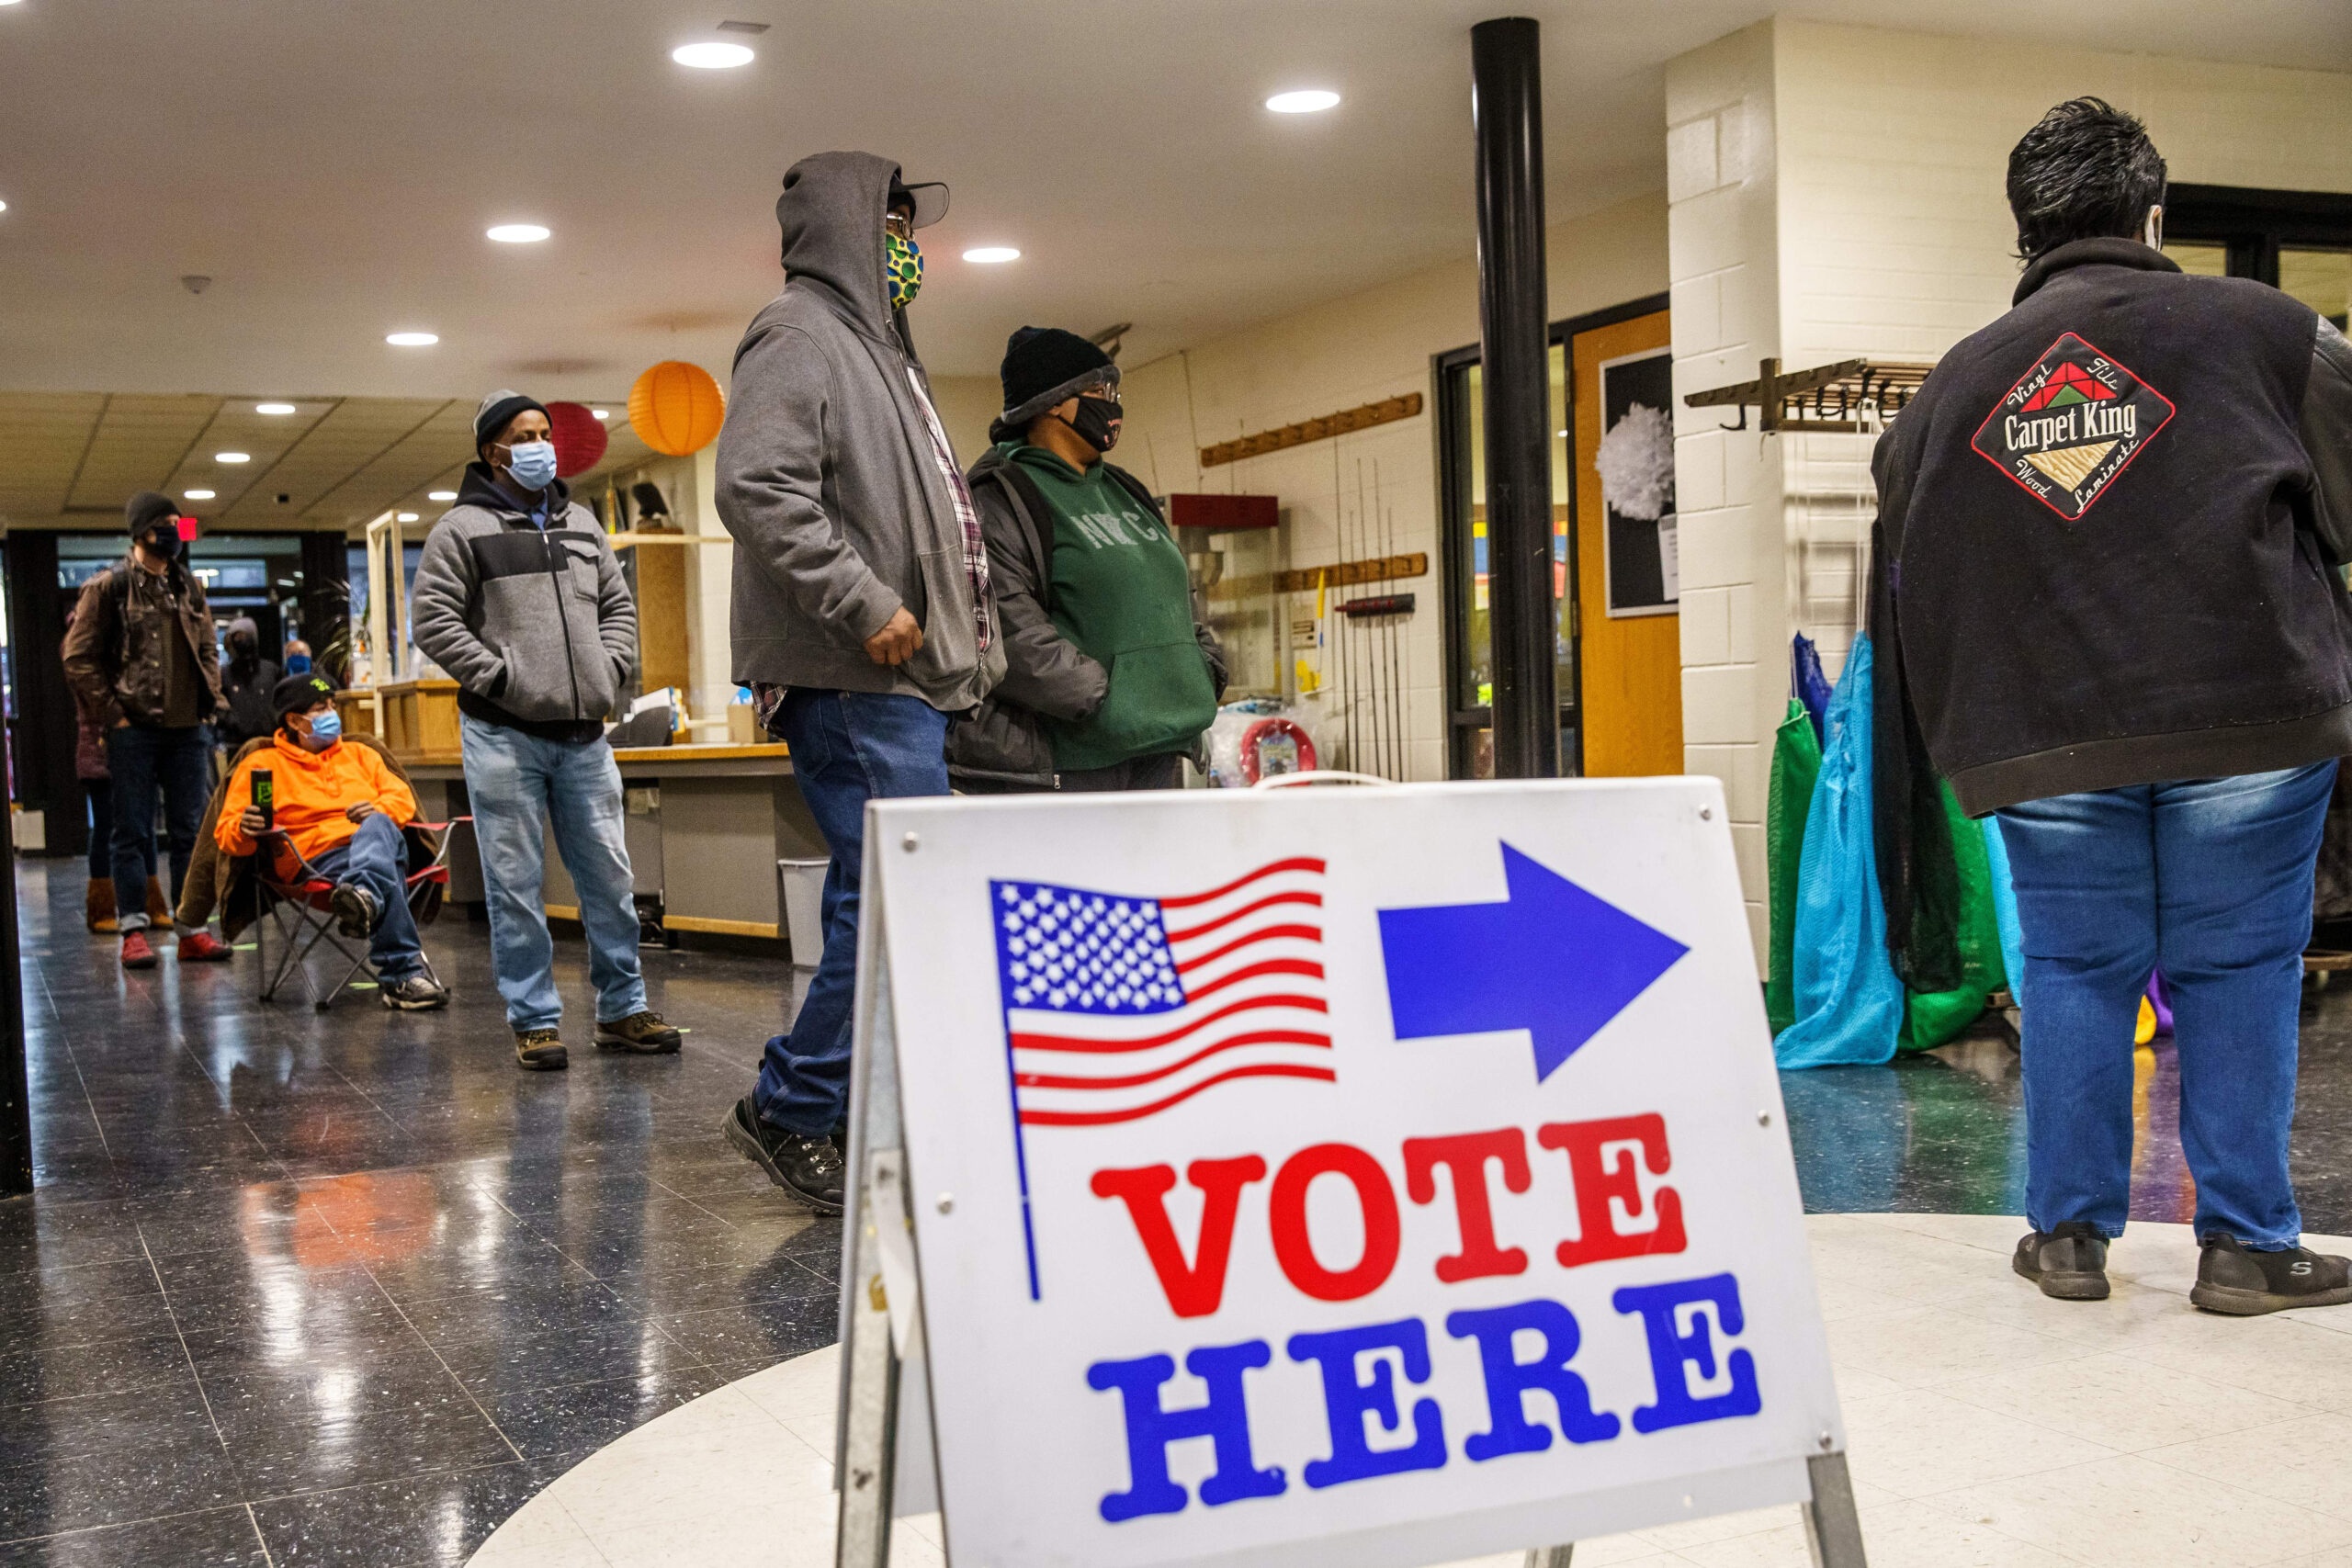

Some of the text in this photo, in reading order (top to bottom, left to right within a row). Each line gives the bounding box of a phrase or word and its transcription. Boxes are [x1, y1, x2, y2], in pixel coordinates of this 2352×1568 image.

[2007, 364, 2053, 407] Vinyl
[2086, 357, 2118, 390] Tile
[2005, 400, 2137, 452] Carpet King
[2016, 459, 2052, 499] Wood
[2075, 438, 2140, 513] Laminate
[1091, 1112, 1687, 1318] VOTE
[2290, 1261, 2312, 1275] S
[1087, 1272, 1762, 1522] HERE
